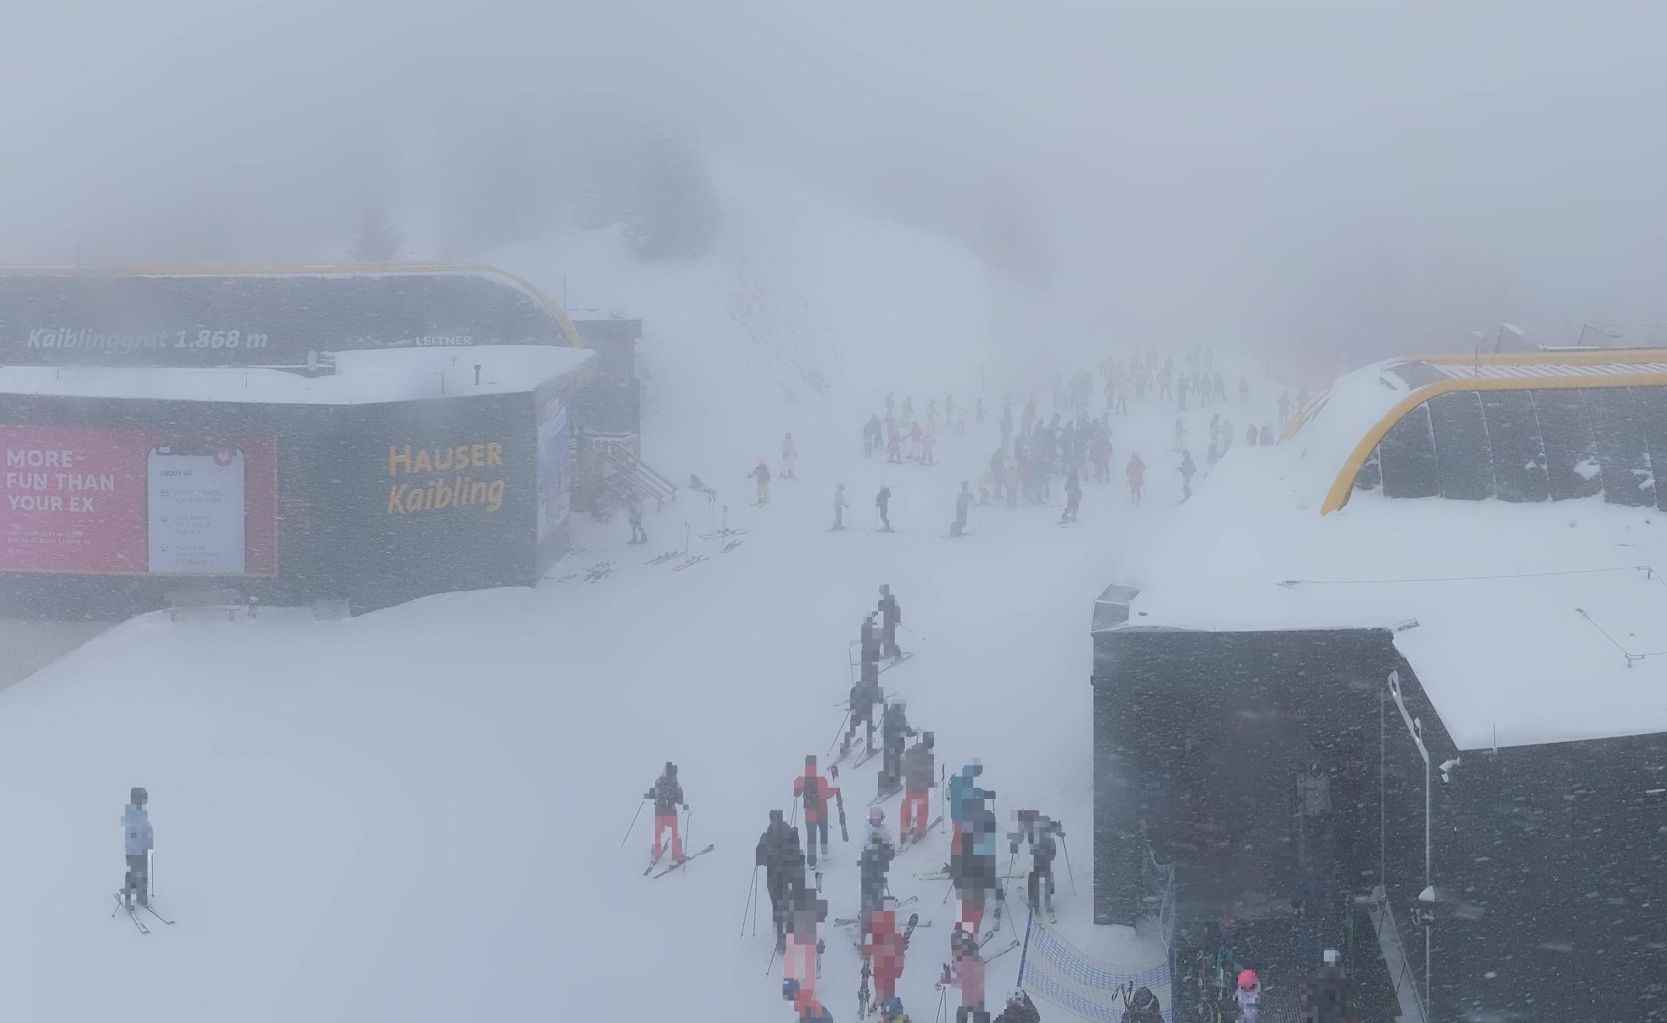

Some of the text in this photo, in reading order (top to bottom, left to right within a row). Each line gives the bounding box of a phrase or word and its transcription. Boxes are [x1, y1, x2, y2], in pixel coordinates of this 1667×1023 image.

[26, 328, 267, 354] Kaiblinggrat 1.868 m
[415, 336, 472, 346] LEITNER
[6, 449, 73, 468] MORE
[388, 442, 503, 476] HAUSER
[6, 472, 115, 491] FUN THAN
[8, 495, 95, 513] YOUR EX
[387, 476, 504, 514] Kaibling
